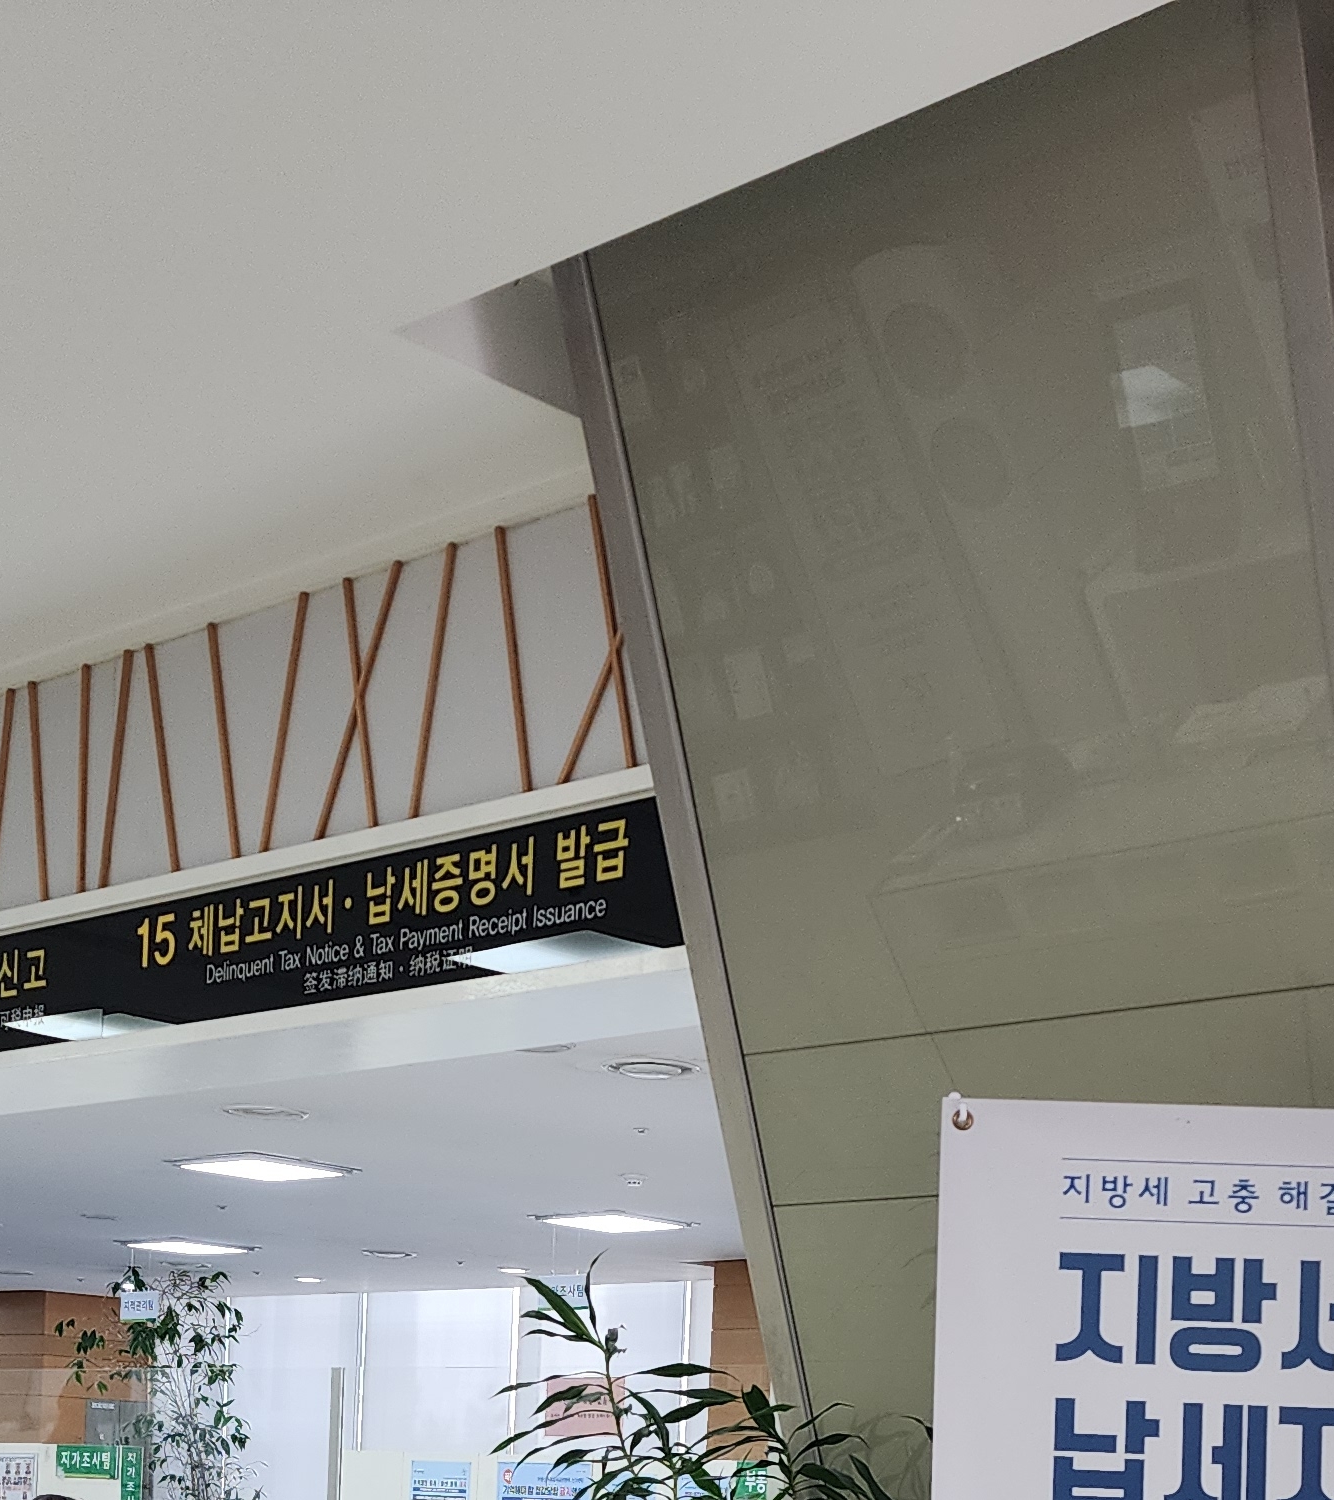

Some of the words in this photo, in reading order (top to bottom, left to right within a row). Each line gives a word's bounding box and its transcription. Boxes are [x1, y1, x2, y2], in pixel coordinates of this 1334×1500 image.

[136, 912, 176, 969] 15
[556, 817, 630, 889] 발급
[205, 958, 274, 986] Delinquent
[278, 951, 301, 974] Tax
[306, 944, 349, 969] Notice
[353, 939, 365, 959] &
[369, 932, 394, 955] Tax
[399, 922, 463, 955] Payment
[468, 911, 527, 943] Receipt
[532, 897, 606, 928] Issuance
[1062, 1173, 1169, 1209] 지방세
[1187, 1179, 1260, 1214] 고충
[60, 1451, 111, 1470] 지가조사팀
